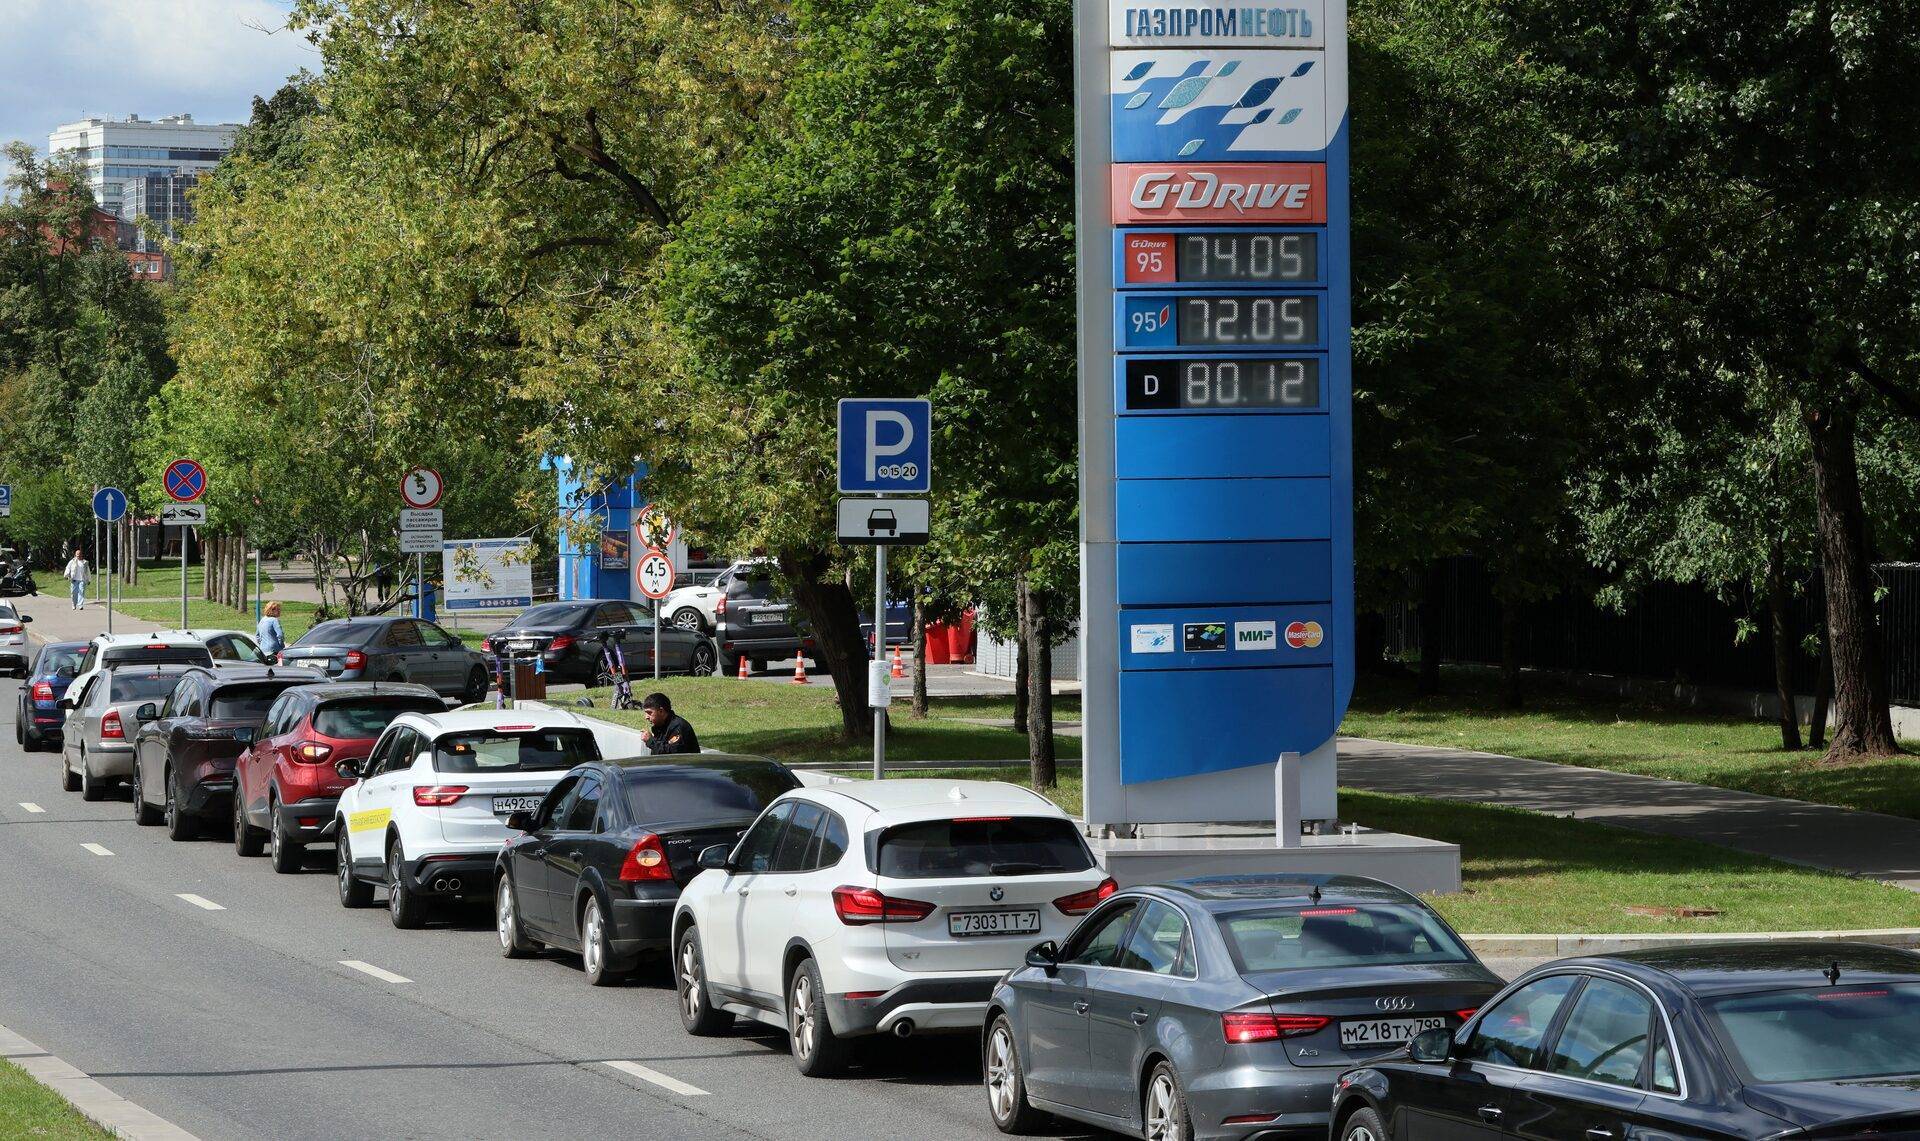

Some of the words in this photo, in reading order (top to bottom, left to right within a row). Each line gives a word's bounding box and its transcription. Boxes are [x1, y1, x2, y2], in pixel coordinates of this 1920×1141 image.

[1125, 8, 1313, 37] ГАЗПРОМНЕФТЬ
[1136, 252, 1163, 273] 95
[1187, 235, 1302, 277] 74.05
[1131, 311, 1157, 333] 95
[1188, 298, 1304, 340] 72.05
[1144, 375, 1160, 395] D
[1186, 361, 1304, 404] 80.12
[865, 410, 914, 481] P
[880, 468, 888, 476] 10
[890, 467, 900, 476] 15
[902, 466, 917, 477] 20
[1239, 630, 1274, 642] МИР
[1287, 631, 1321, 639] MasterCard
[1298, 1048, 1319, 1056] A3
